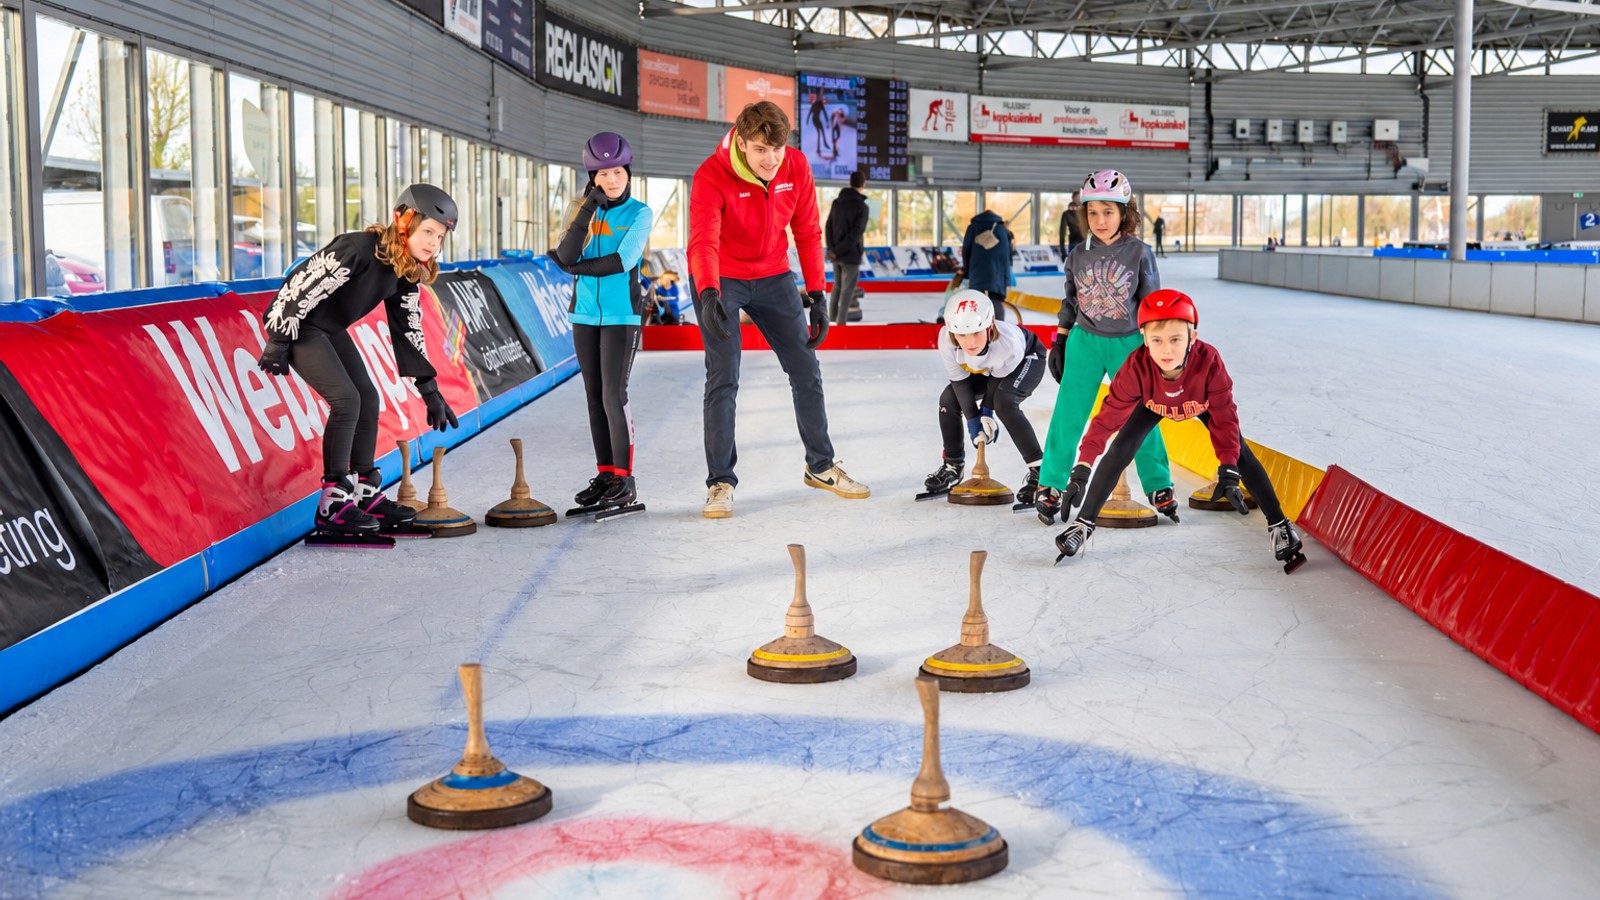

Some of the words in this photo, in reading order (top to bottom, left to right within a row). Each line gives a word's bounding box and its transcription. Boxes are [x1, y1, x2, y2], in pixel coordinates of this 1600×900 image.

[545, 21, 622, 96] RECLASIGN
[1064, 104, 1080, 114] Voor
[1082, 105, 1091, 115] de
[1585, 212, 1596, 227] 2
